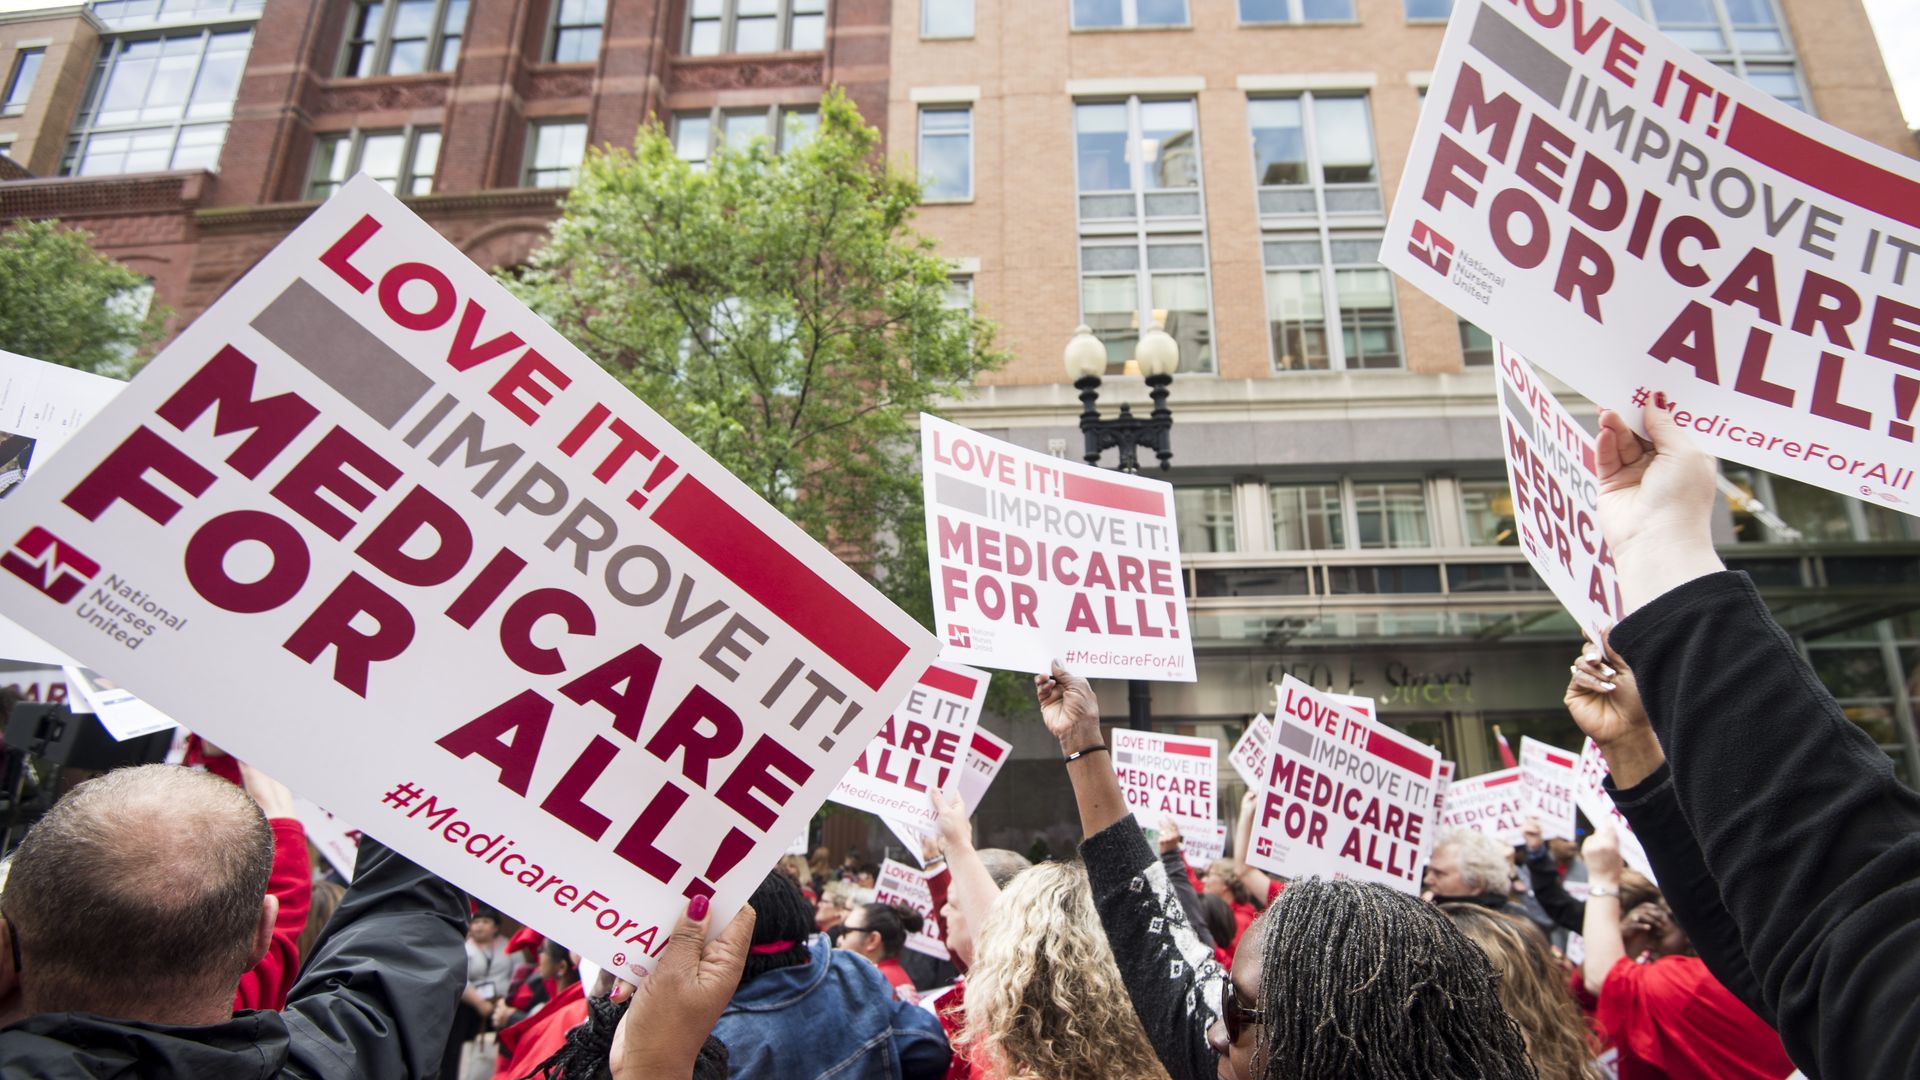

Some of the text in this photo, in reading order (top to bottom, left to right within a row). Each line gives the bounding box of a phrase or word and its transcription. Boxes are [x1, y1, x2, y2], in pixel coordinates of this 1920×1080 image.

[1508, 0, 1730, 140] OVE IT!
[1568, 74, 1845, 262] IMPROVE
[1445, 61, 1920, 371] MEDICARE
[1422, 133, 1920, 443] FOR ALL!
[1452, 274, 1490, 305] United
[1455, 261, 1493, 294] Nurses
[1459, 250, 1506, 288] National
[319, 213, 679, 511] LOVE IT!
[1500, 341, 1581, 461] LOVE IT!
[933, 431, 1060, 498] LOVE IT!
[991, 490, 1169, 552] IMPROVE IT!
[1513, 464, 1575, 580] FOR
[155, 343, 815, 833] MEDICARE
[402, 393, 864, 752] IMPROVE IT!
[937, 515, 1175, 596] MEDICARE
[76, 602, 144, 650] United
[89, 588, 157, 636] Nurses
[103, 574, 188, 632] National
[941, 564, 1180, 639] FOR ALL!
[60, 424, 757, 900] FOR ALL!
[1065, 650, 1185, 668] #MedicareForAll
[1380, 660, 1474, 704] Street
[933, 698, 970, 728] IT!
[1116, 735, 1163, 752] LOVE IT!
[1285, 688, 1368, 749] LOVE IT!
[1116, 767, 1211, 798] MEDICARE
[1133, 753, 1212, 776] IMPROVE IT!
[1312, 736, 1430, 809] IMPROVE IT!
[1120, 787, 1211, 820] OR ALL!
[1269, 753, 1425, 846] MEDICARE
[1262, 791, 1419, 882] FOR ALL!
[381, 780, 672, 961] #MedicareForAl
[885, 864, 914, 883] LOVE
